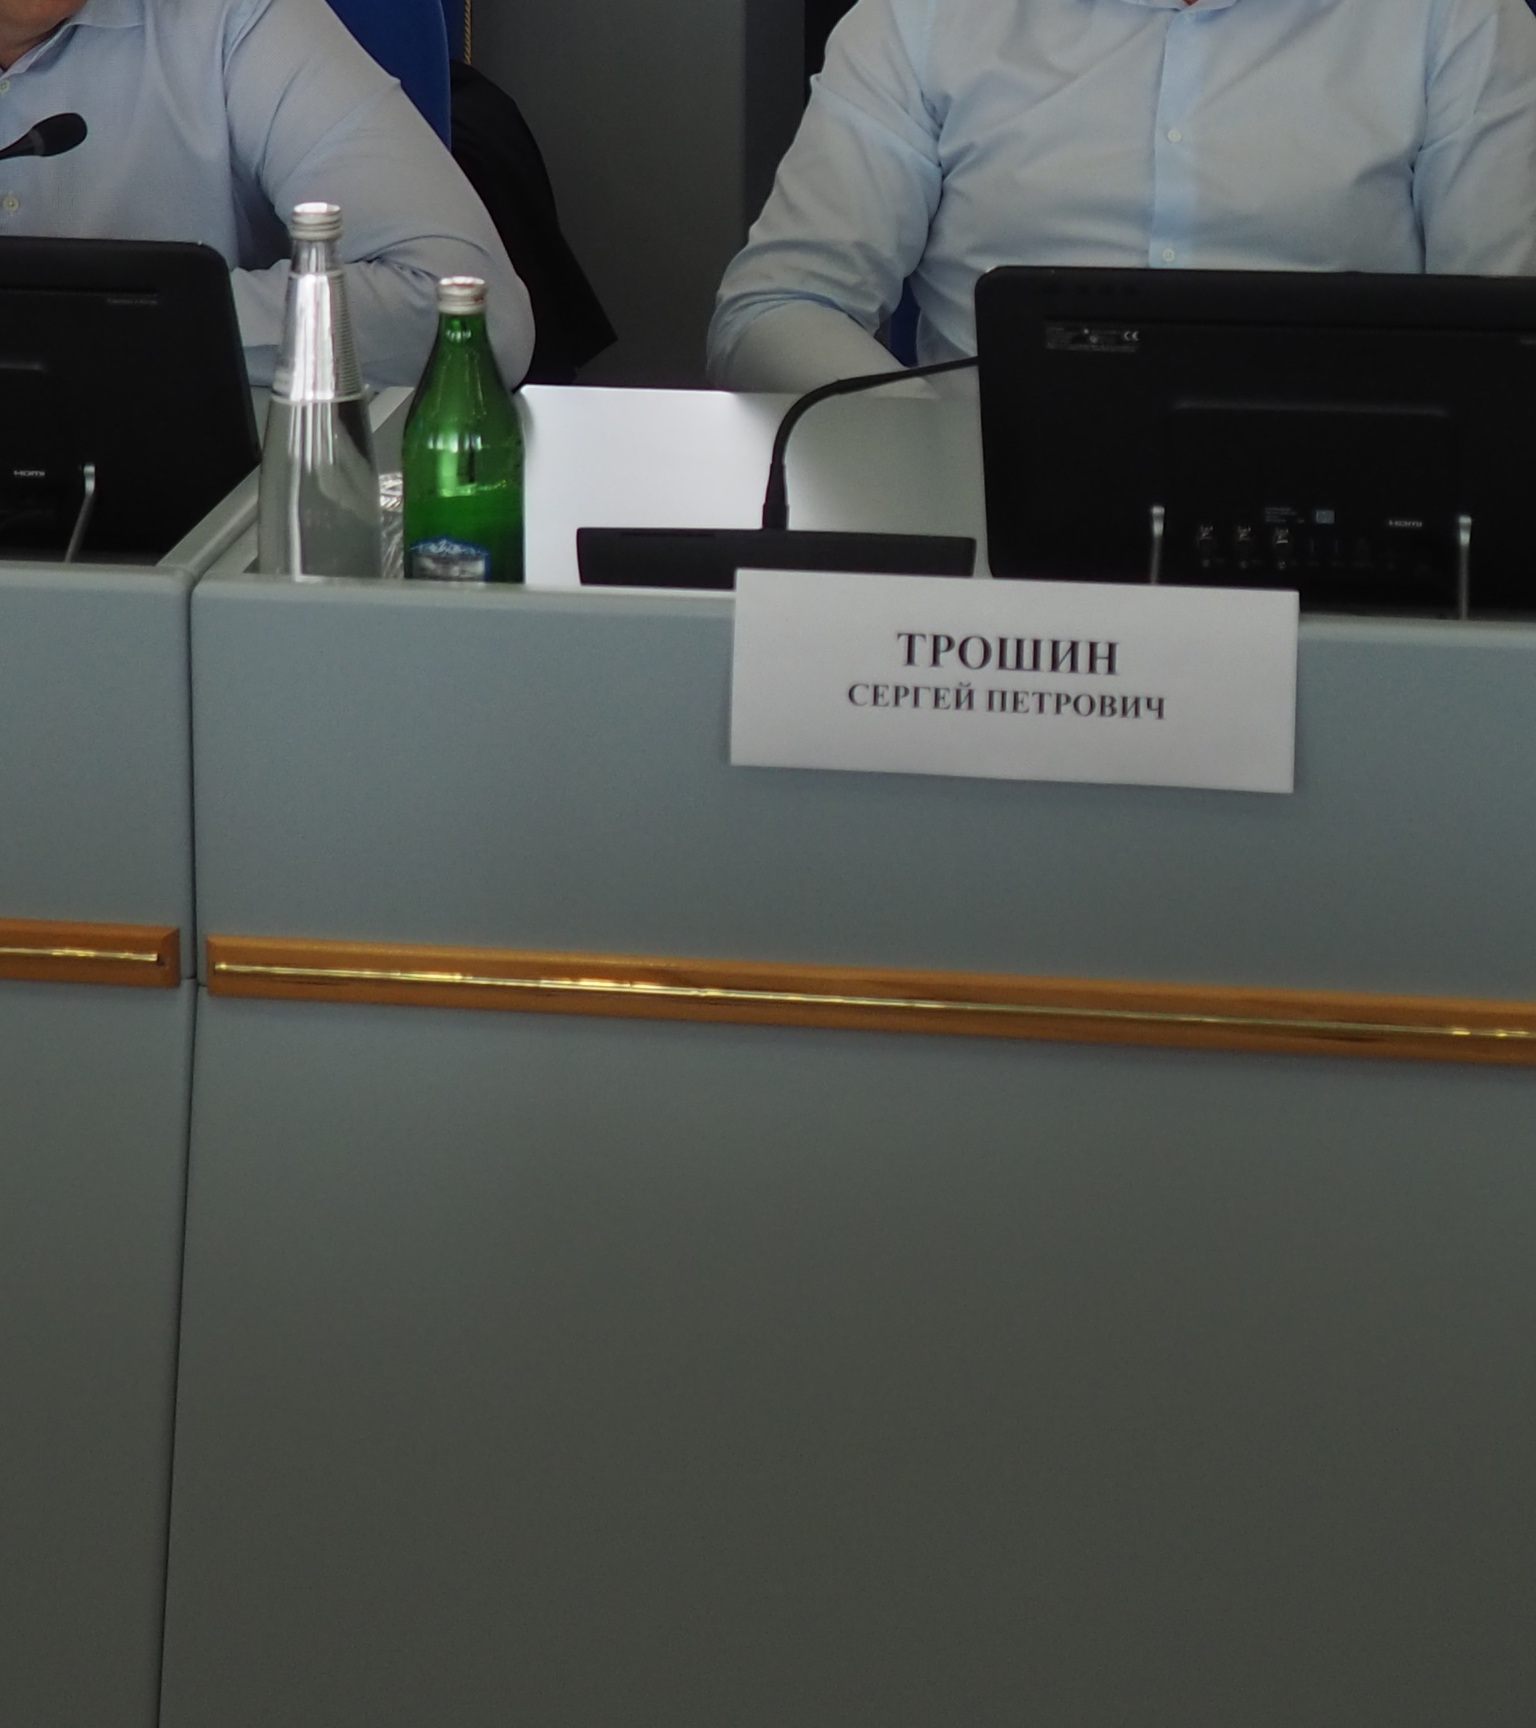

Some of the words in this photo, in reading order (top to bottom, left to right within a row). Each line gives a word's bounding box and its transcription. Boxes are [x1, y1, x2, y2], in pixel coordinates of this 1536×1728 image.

[896, 632, 1120, 676] ТРОШИН
[847, 681, 976, 712] СЕРГЕЙ
[986, 689, 1166, 721] ПЕТРОВИЧ
